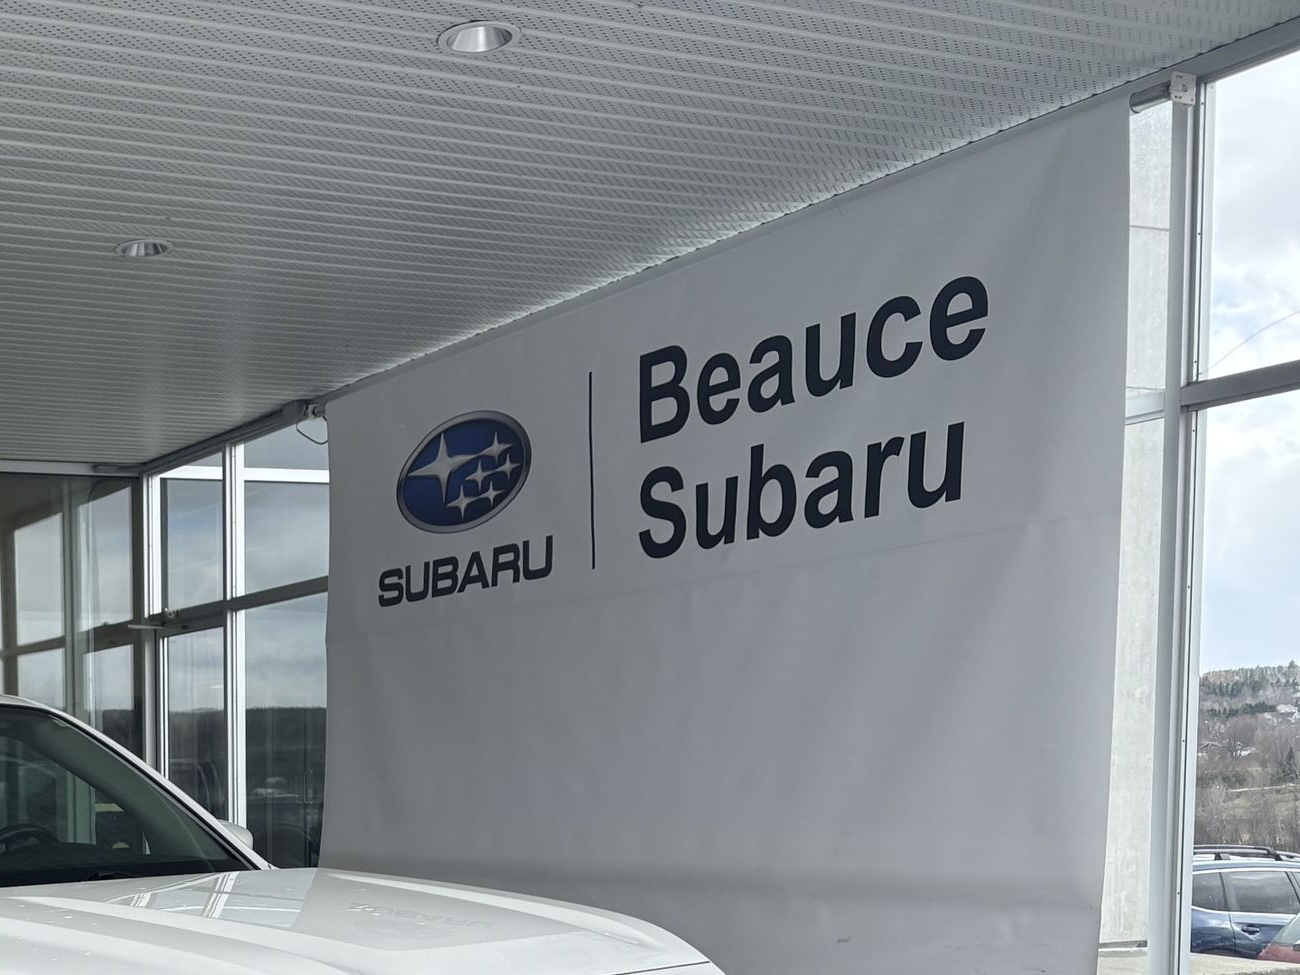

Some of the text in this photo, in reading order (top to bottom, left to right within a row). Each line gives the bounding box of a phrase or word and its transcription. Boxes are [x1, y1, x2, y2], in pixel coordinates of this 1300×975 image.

[639, 276, 989, 443] Beauce
[638, 421, 965, 559] Subaru
[377, 535, 554, 608] SUBARU
